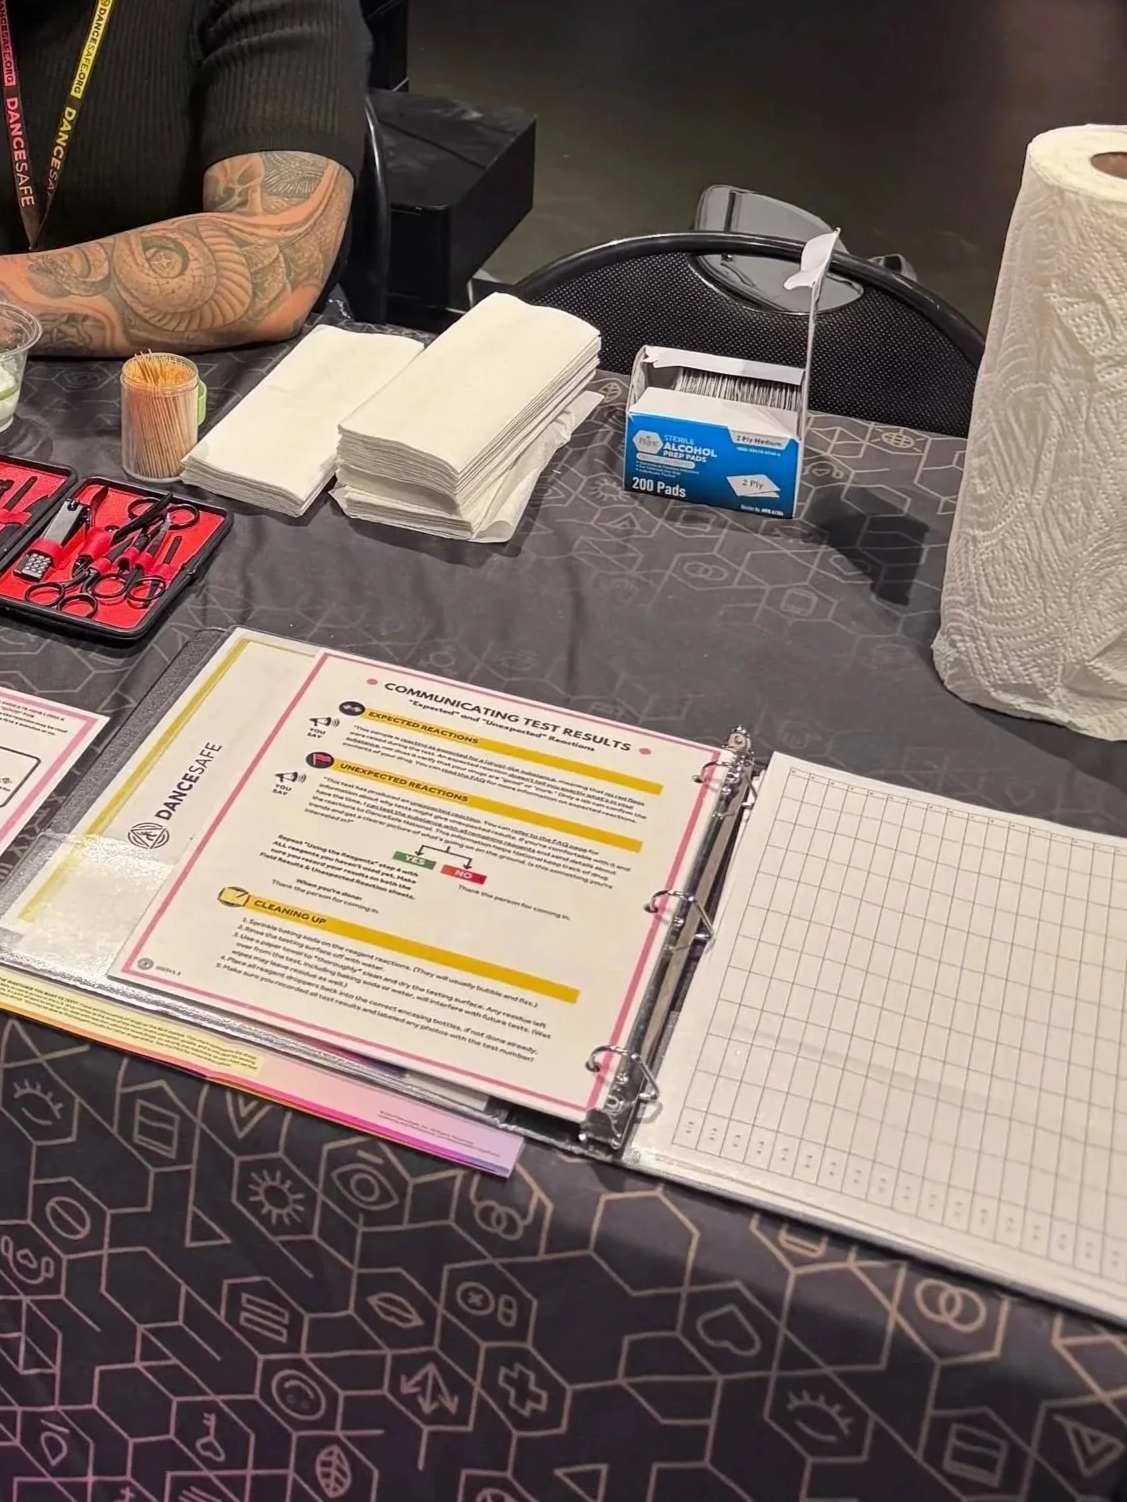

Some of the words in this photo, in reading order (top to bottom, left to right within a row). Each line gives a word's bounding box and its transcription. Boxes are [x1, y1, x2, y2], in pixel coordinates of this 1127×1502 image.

[73, 7, 107, 95] DANCESAFE.ORG
[6, 97, 34, 207] DANCESAFE
[47, 106, 77, 194] DANCESA
[663, 442, 717, 458] ALCOHOL
[664, 435, 694, 445] STERILE
[754, 437, 782, 447] Medium
[662, 450, 684, 460] PREP
[686, 455, 707, 463] PADS
[632, 477, 654, 492] 200
[657, 483, 686, 498] Pads
[750, 480, 763, 490] Ply
[368, 712, 420, 729] EXPECTED
[421, 724, 479, 744] REACTIONS
[384, 683, 519, 725] COMMUNICATING
[523, 717, 560, 736] TEST
[562, 727, 631, 752] RESULTS
[310, 727, 325, 735] YOU
[460, 713, 480, 722] and
[547, 735, 595, 753] Reactions
[154, 742, 222, 820] DANCESAFE
[340, 763, 407, 786] UNEXPECTED
[408, 781, 469, 802] REACTIONS
[404, 855, 425, 865] YES
[455, 869, 474, 879] NO
[254, 900, 311, 920] CLEANING
[312, 915, 327, 924] UP
